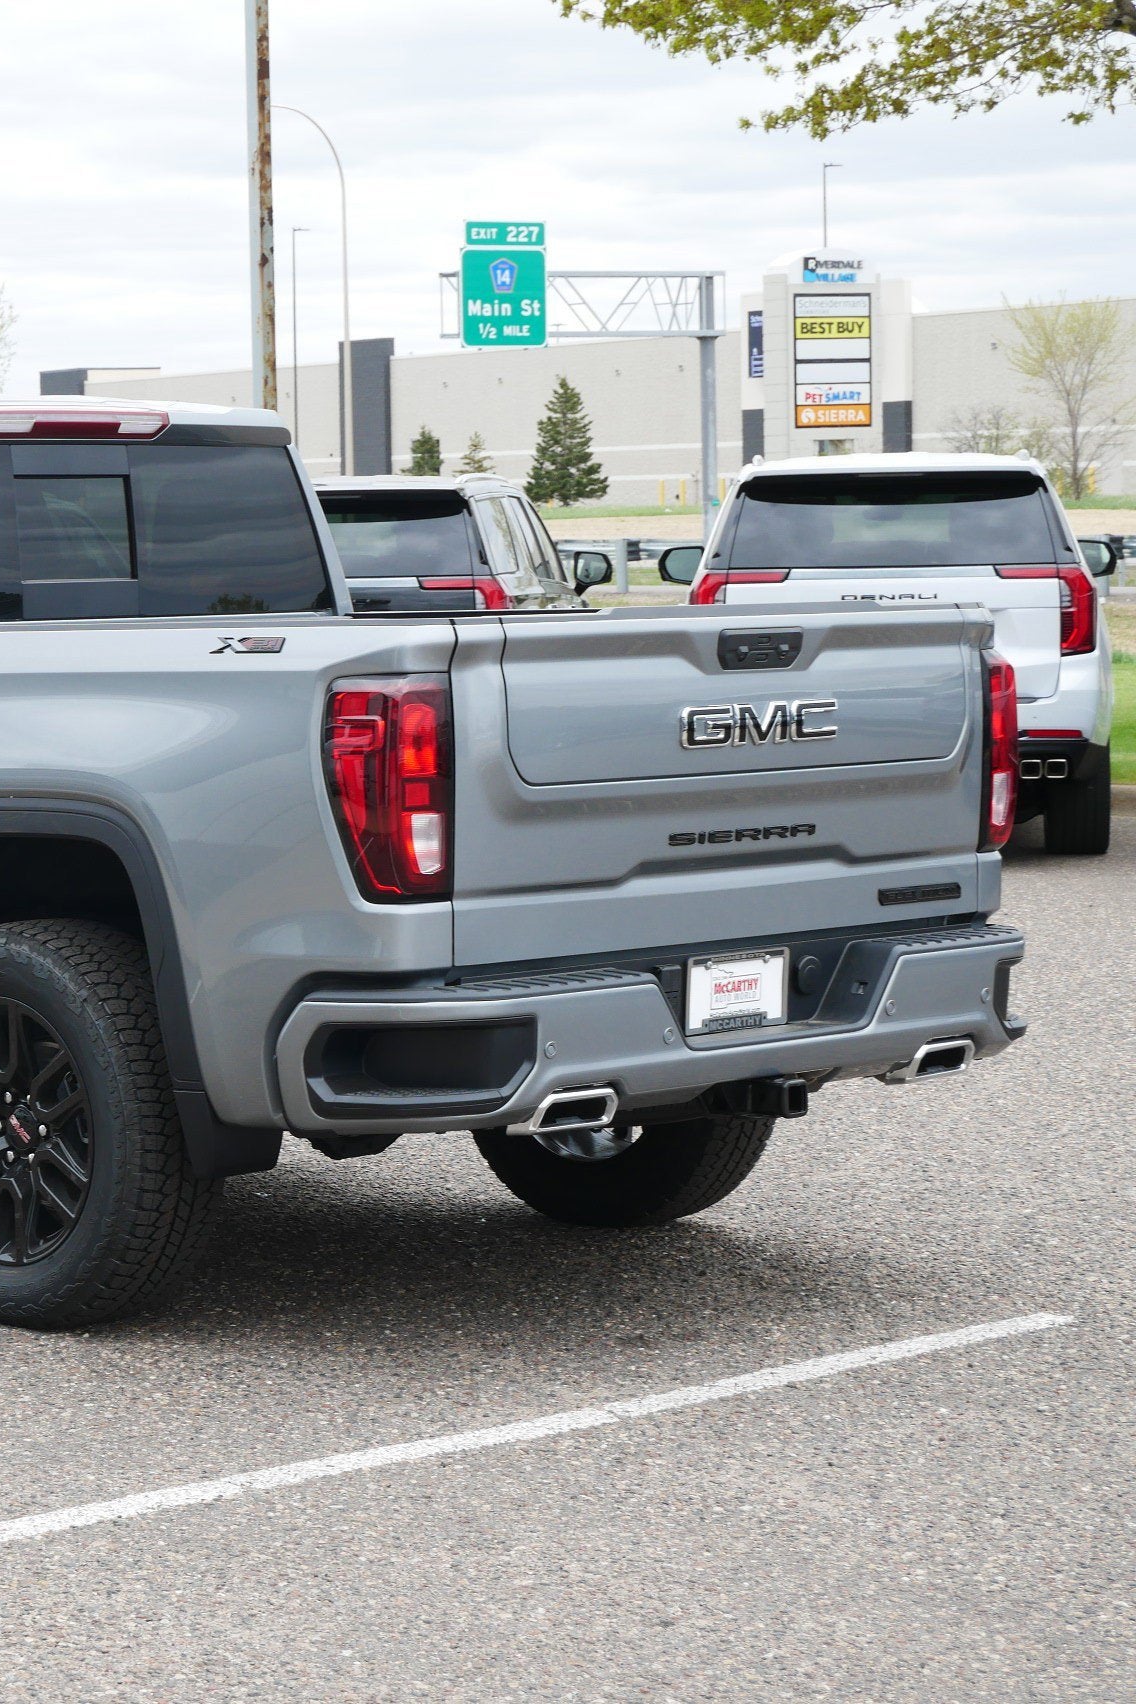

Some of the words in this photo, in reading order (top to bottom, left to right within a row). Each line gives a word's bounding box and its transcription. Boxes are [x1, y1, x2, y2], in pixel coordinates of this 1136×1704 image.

[471, 228, 498, 239] EXIT
[506, 226, 539, 242] 227
[496, 269, 511, 285] 14
[816, 273, 857, 282] VILLAGE
[468, 299, 512, 316] Main
[520, 299, 541, 316] St
[503, 325, 530, 336] MILE
[800, 322, 834, 334] BEST
[837, 321, 865, 333] BUY
[817, 409, 866, 423] SIERRA
[680, 698, 839, 750] GMC
[668, 823, 816, 846] SIERRA
